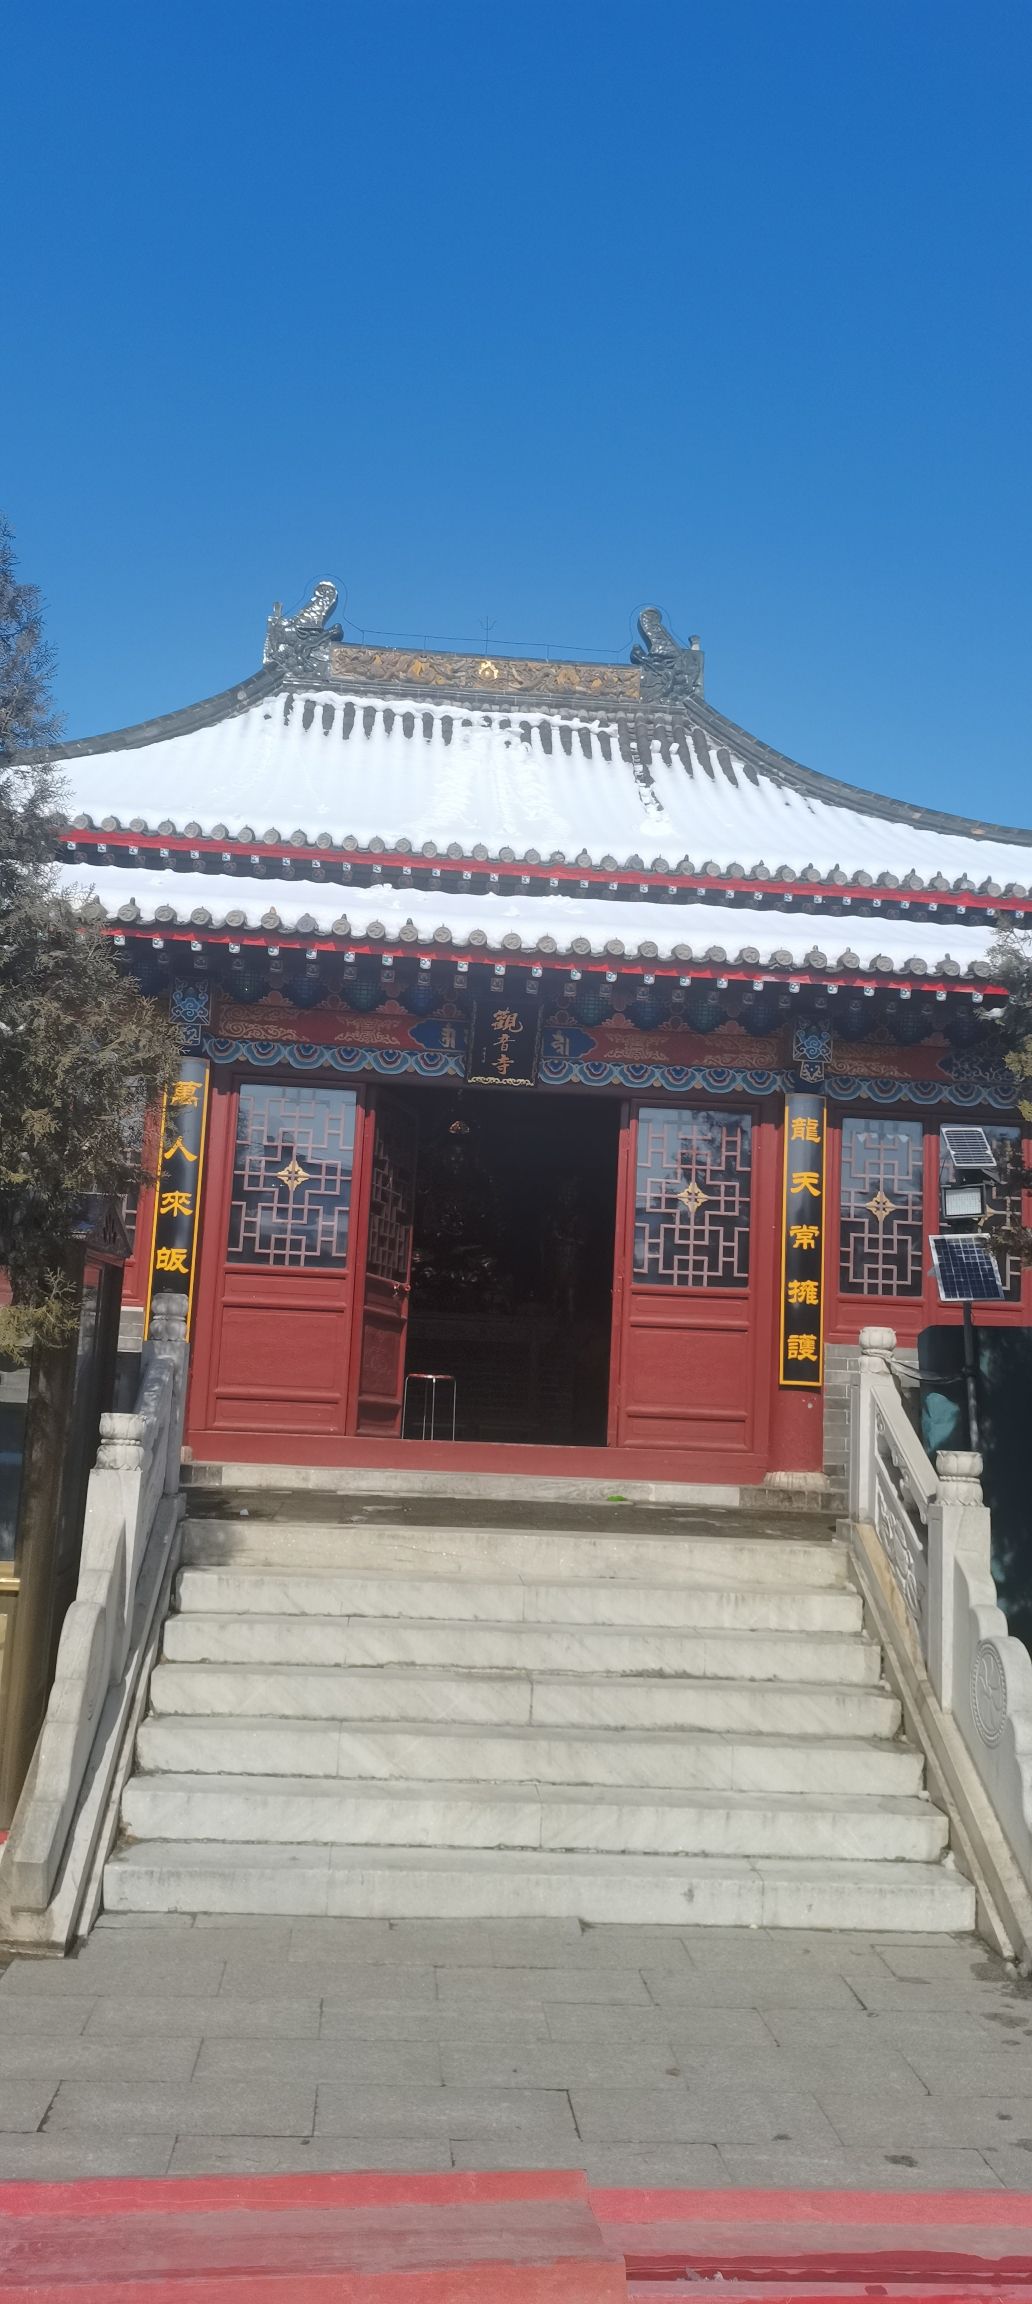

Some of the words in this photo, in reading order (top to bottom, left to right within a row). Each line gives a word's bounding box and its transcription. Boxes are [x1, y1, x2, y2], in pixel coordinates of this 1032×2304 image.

[491, 1007, 523, 1075] 觀音寺
[156, 1081, 203, 1273] 萬人來皈
[787, 1117, 821, 1361] 龍天常擁護
